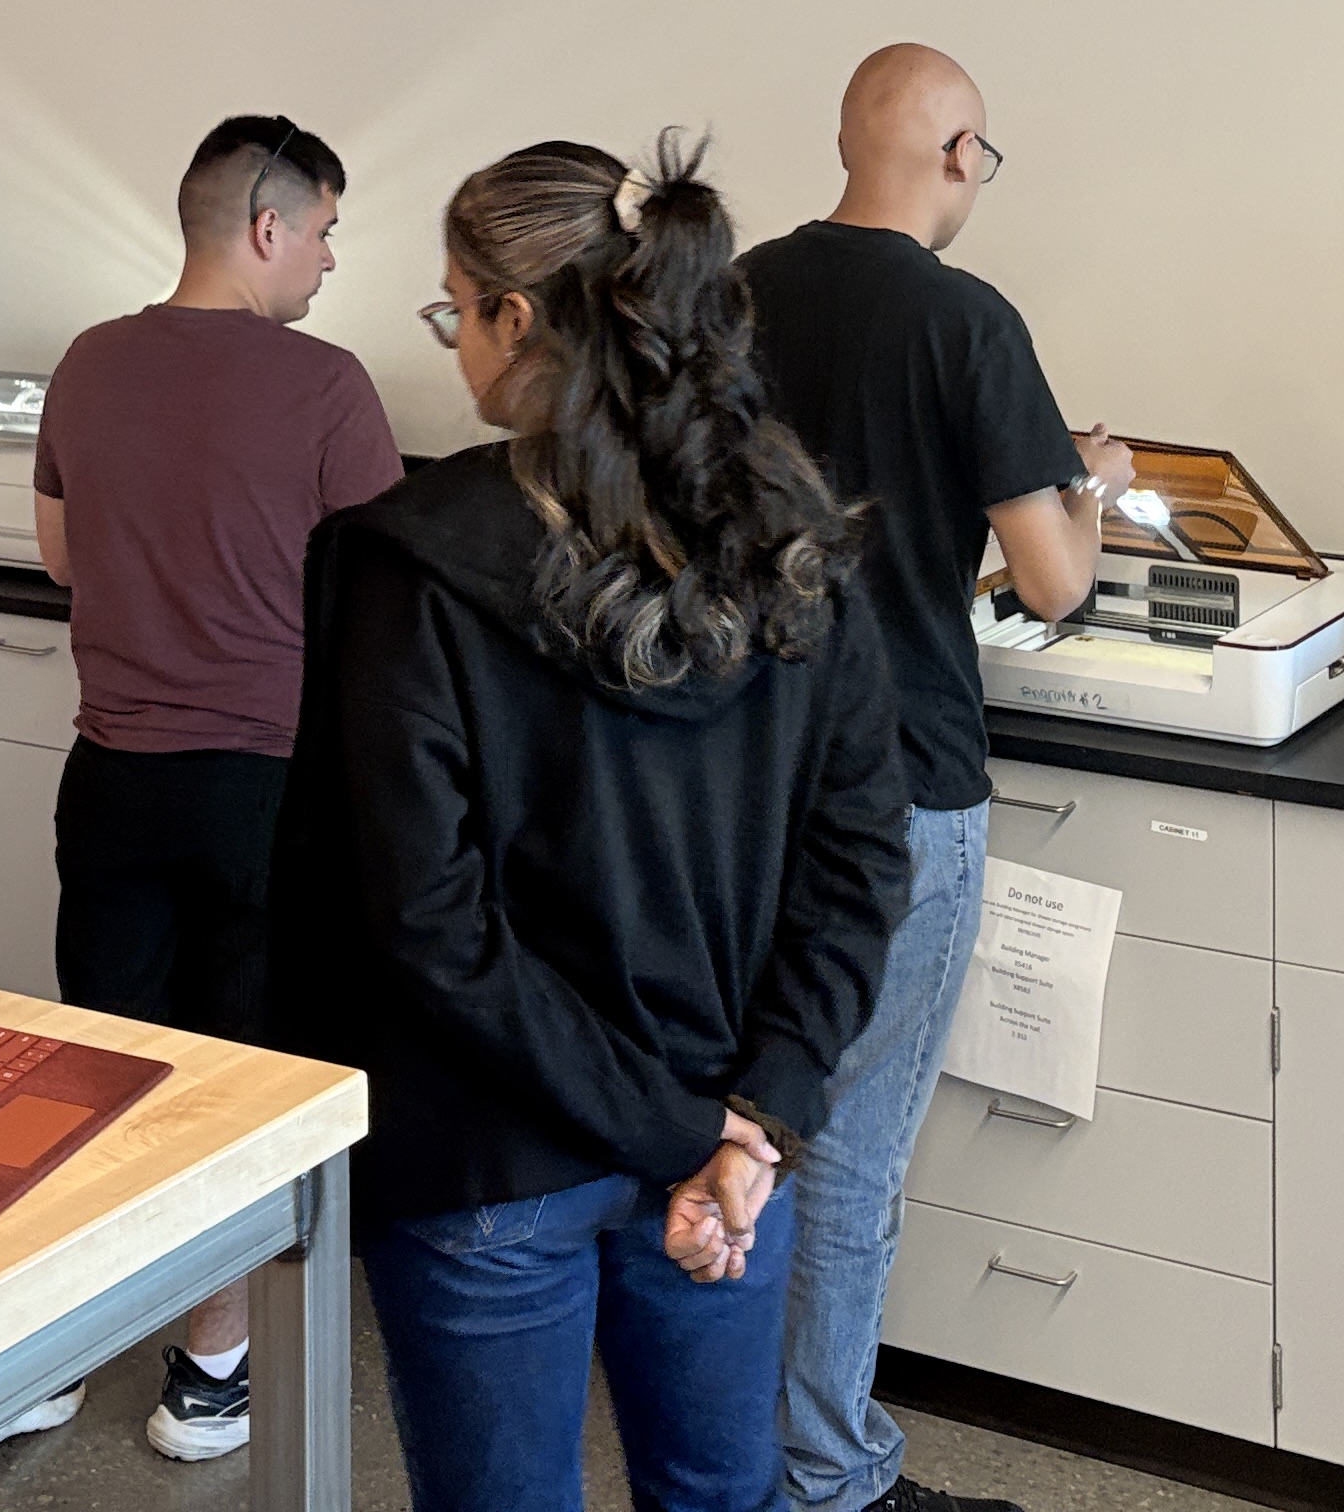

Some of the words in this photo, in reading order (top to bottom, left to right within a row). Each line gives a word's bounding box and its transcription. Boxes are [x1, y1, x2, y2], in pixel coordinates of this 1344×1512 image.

[1007, 887, 1023, 900] Do
[1024, 893, 1043, 907] not
[1045, 899, 1065, 912] use
[1001, 944, 1024, 956] Building
